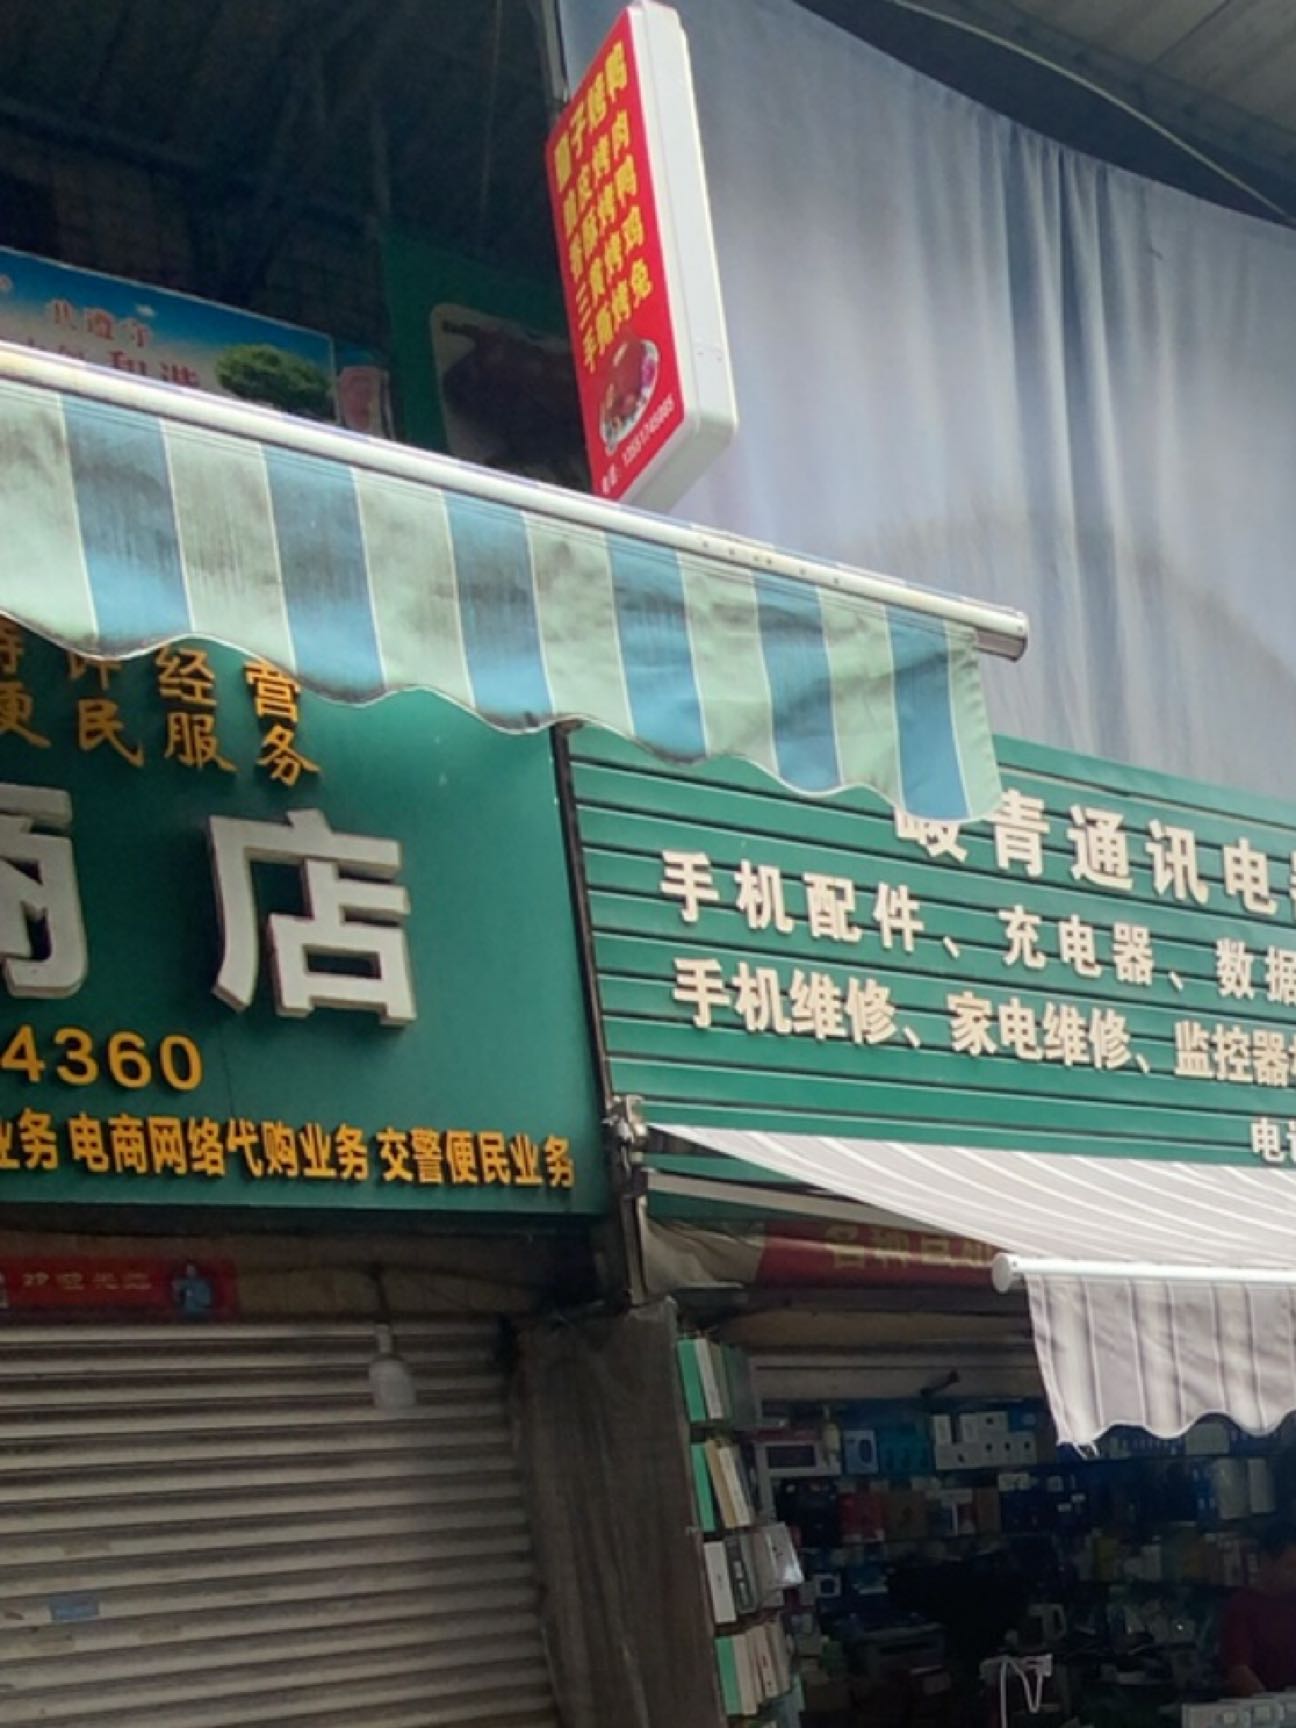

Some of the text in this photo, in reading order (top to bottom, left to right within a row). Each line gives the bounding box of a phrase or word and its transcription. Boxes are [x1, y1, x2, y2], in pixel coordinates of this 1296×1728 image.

[0, 1025, 203, 1091] 4360
[67, 1111, 369, 1183] 电商网络代购业务
[375, 1128, 574, 1189] 交警便民业务
